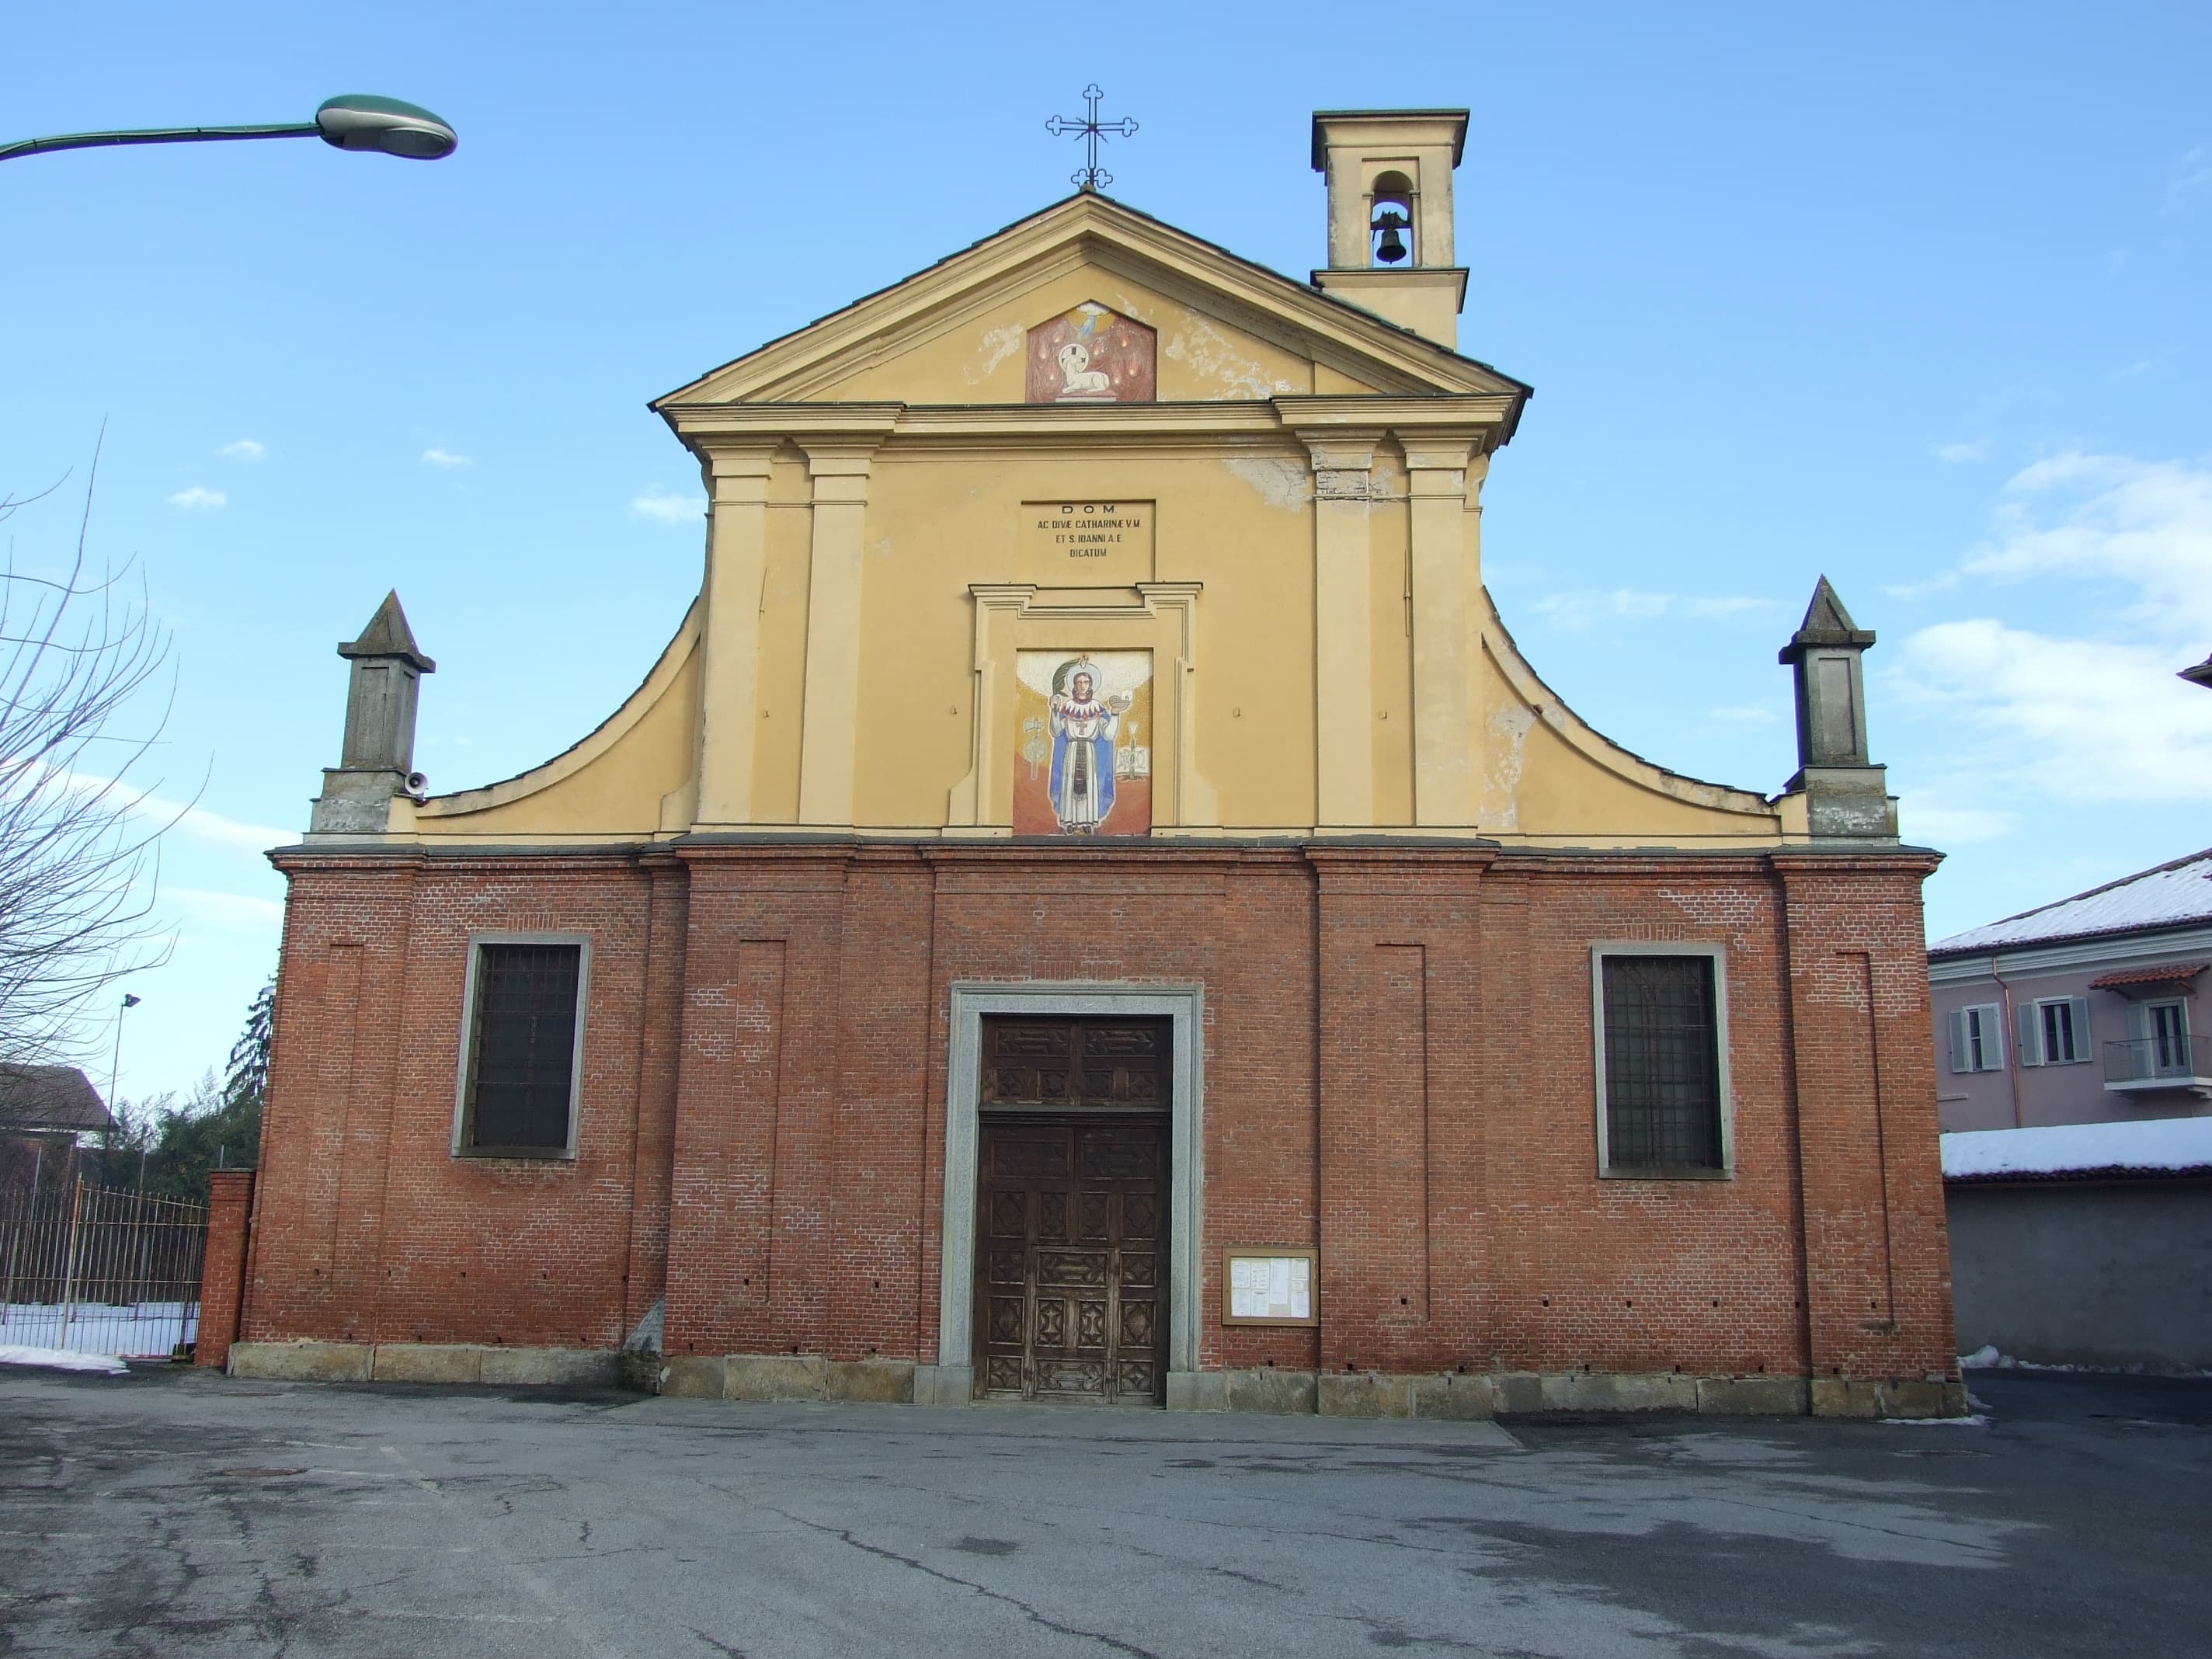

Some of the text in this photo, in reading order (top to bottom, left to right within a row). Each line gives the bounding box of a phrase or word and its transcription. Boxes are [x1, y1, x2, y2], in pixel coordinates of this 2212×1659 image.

[1038, 520, 1049, 529] AC
[1056, 534, 1065, 543] ET
[1069, 548, 1107, 558] DICATUM
